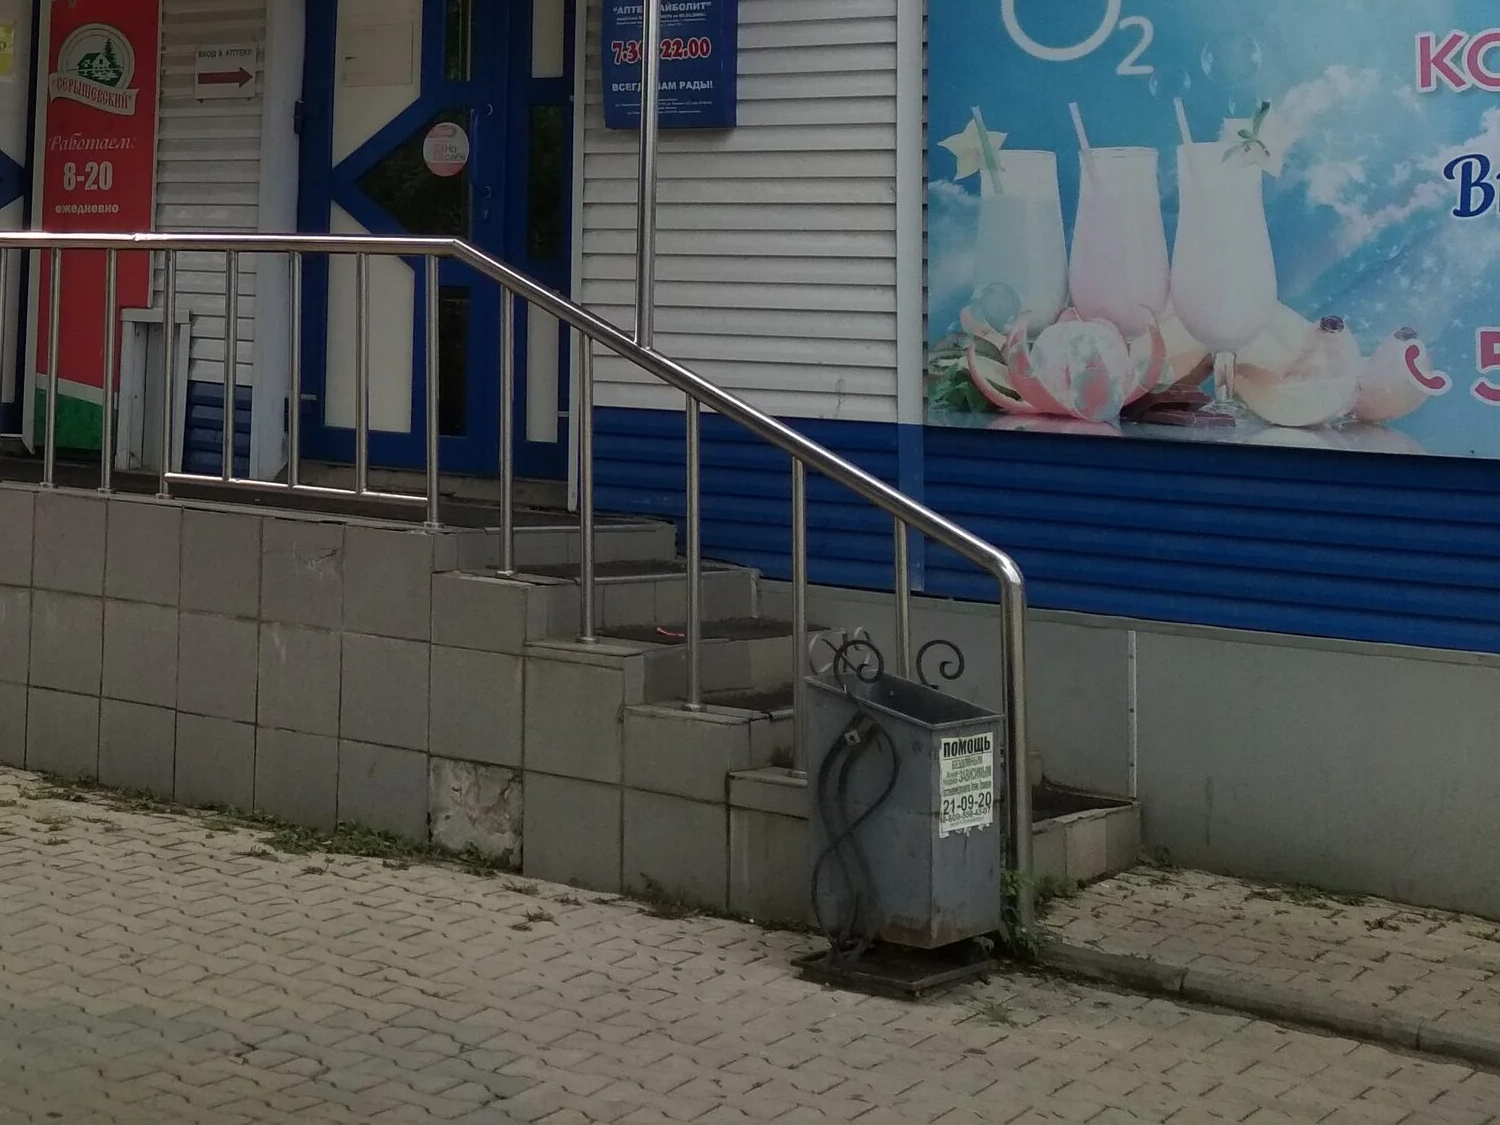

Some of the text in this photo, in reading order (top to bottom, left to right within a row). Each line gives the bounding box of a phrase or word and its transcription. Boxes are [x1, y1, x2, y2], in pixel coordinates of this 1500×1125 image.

[679, 80, 713, 90] РАДЫ!
[63, 161, 113, 191] 8-20
[55, 203, 120, 215] ежедневно
[943, 736, 991, 758] ПОМОЩЬ
[942, 791, 992, 815] 21-09-20
